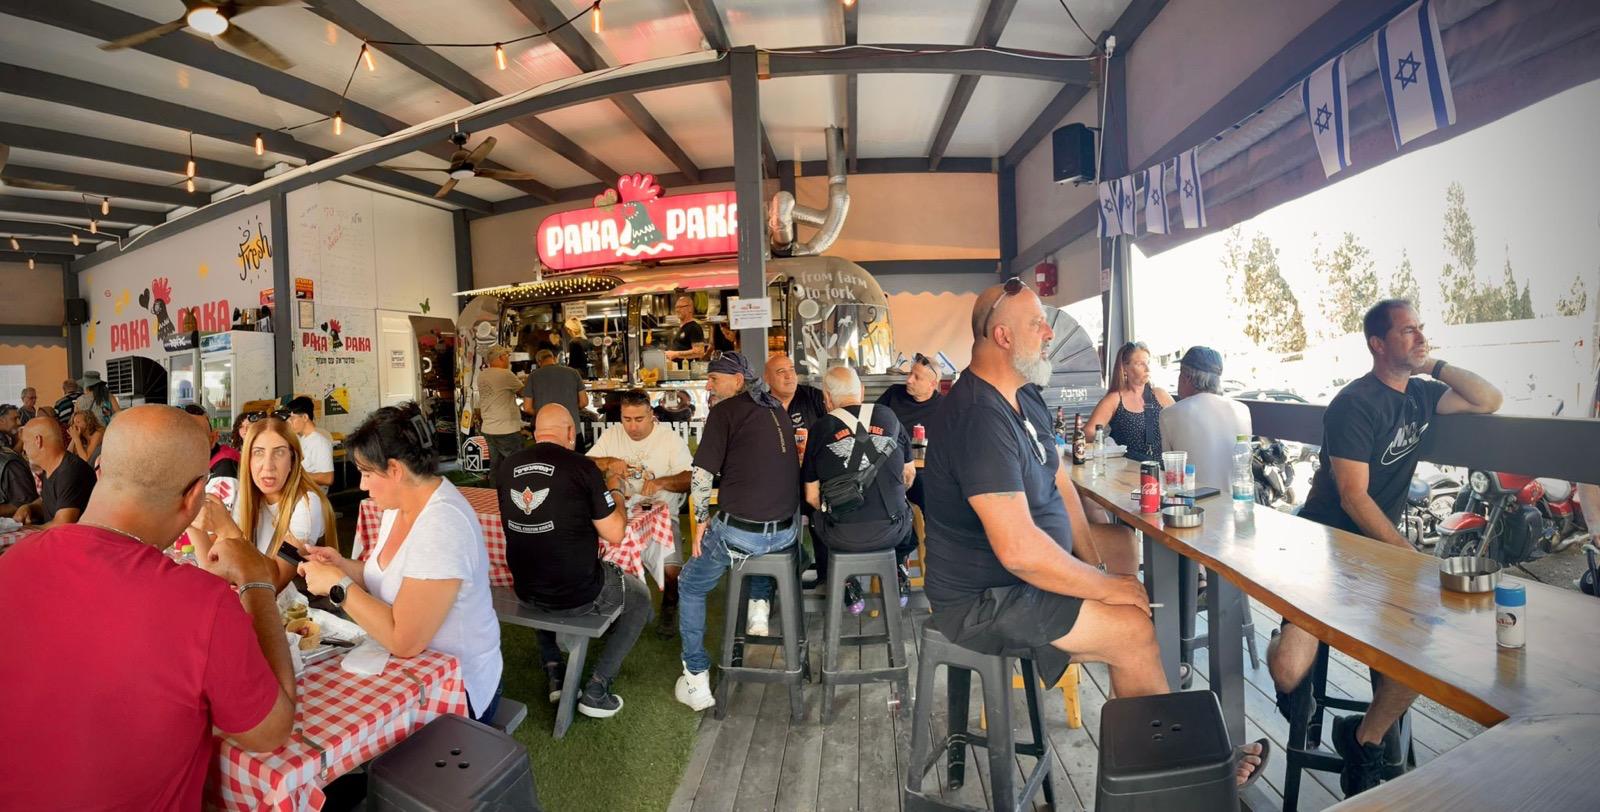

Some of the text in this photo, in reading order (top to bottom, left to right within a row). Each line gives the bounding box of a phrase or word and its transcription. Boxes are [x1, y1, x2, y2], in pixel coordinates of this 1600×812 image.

[238, 222, 272, 280] Fresh
[546, 219, 619, 257] PAKA
[801, 270, 867, 289] from farm
[806, 283, 856, 300] to fork
[110, 319, 150, 352] PAKA
[302, 332, 371, 352] PAKA PAKA
